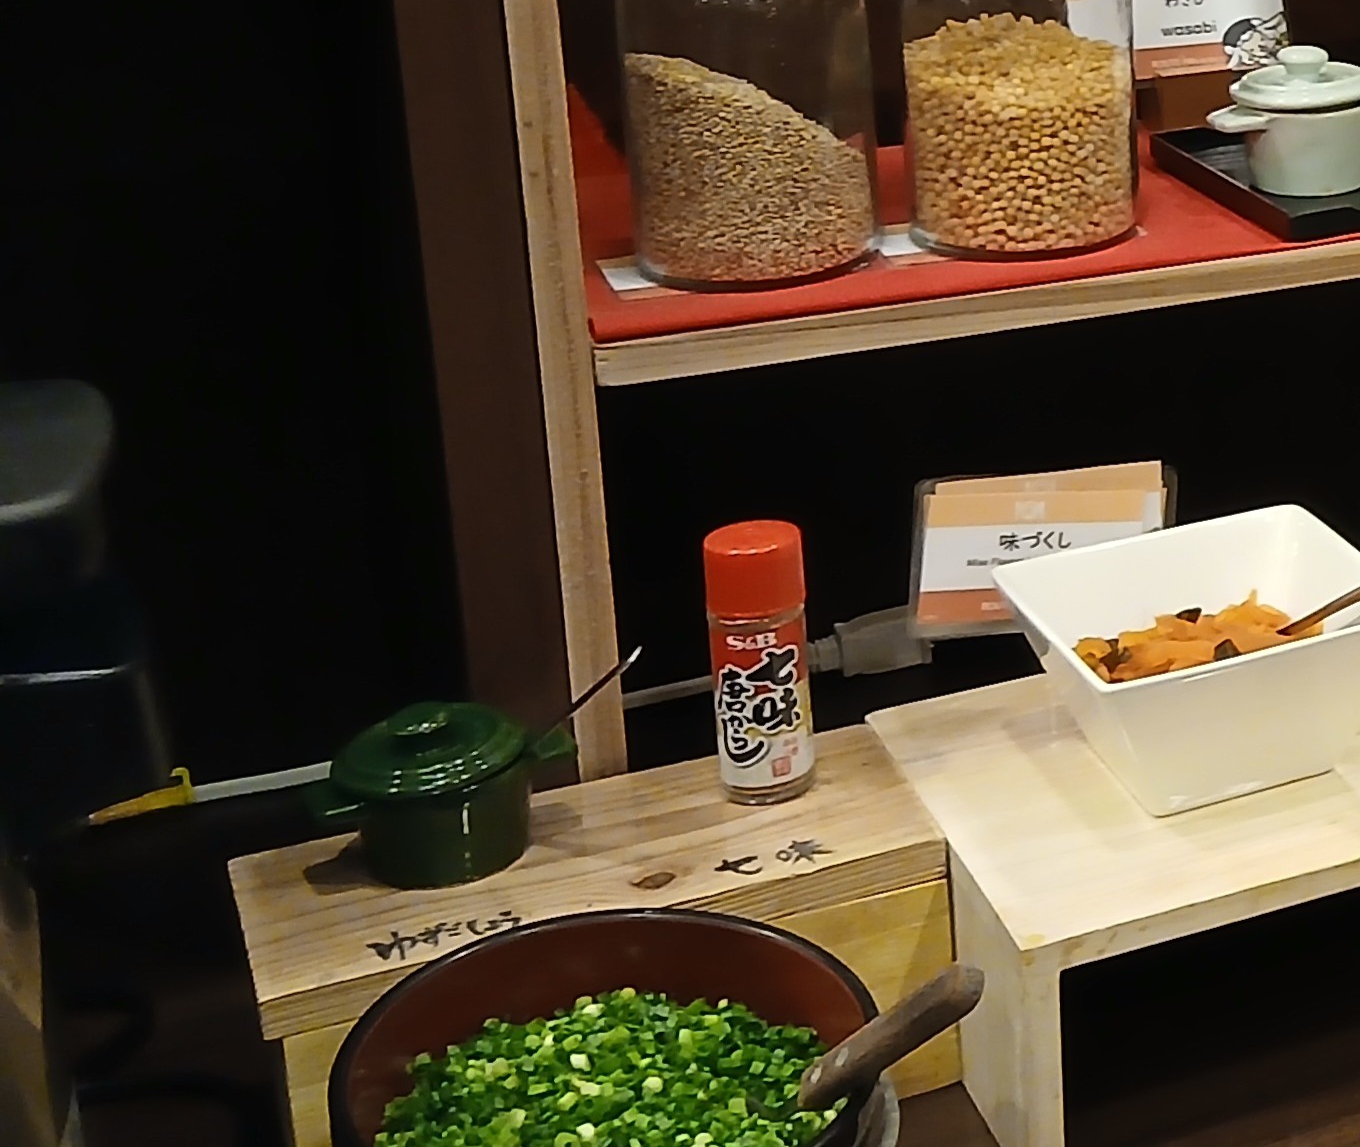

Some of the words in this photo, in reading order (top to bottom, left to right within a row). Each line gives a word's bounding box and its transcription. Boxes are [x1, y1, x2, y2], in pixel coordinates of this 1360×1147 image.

[1160, 20, 1218, 37] wasabi
[999, 530, 1072, 552] 味づくし
[725, 631, 778, 651] S&B
[713, 838, 836, 877] 七味
